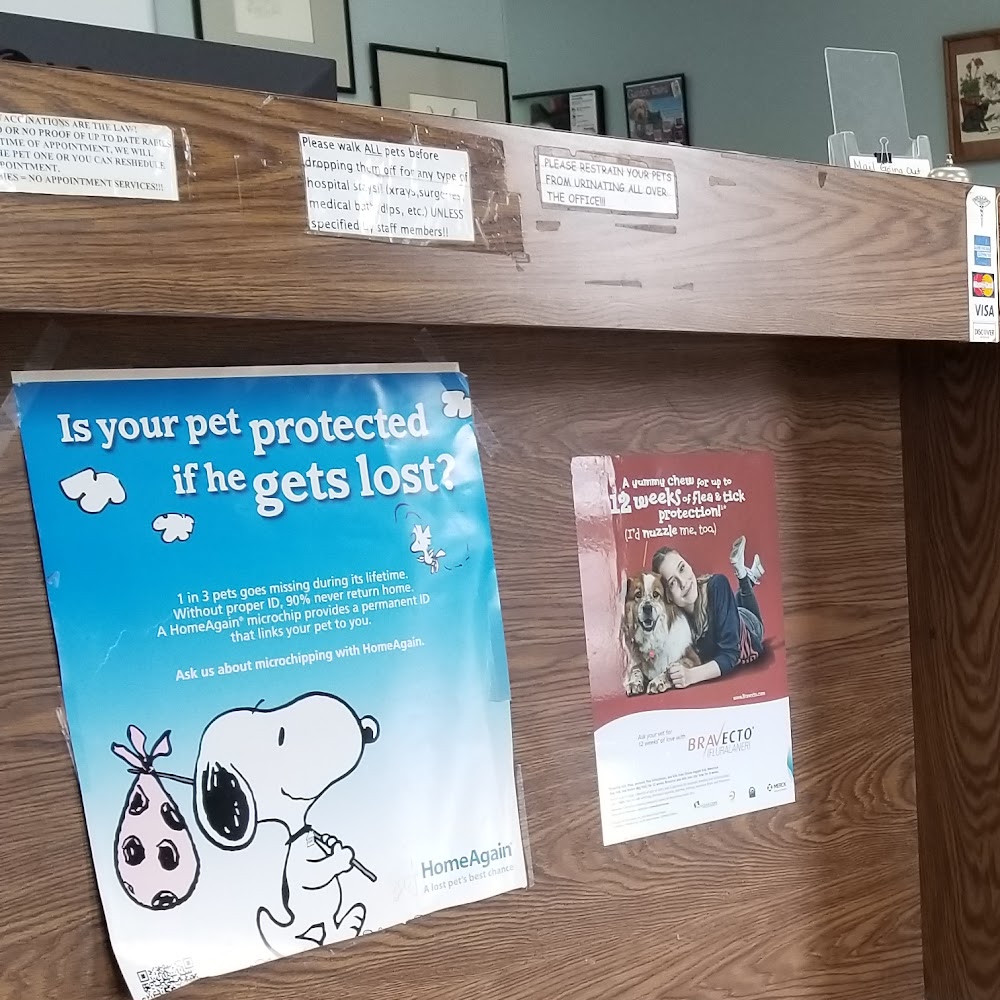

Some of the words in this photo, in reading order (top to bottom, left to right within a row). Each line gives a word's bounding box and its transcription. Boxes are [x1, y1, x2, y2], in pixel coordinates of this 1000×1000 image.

[0, 114, 70, 127] ACCINATIONS
[72, 121, 91, 130] ARE
[92, 122, 111, 131] THE
[5, 126, 20, 135] OR
[22, 128, 36, 136] NO
[39, 129, 72, 139] PROOF
[73, 131, 86, 140] OF
[88, 133, 100, 141] UP
[102, 134, 115, 142] TO
[117, 135, 140, 144] DATE
[0, 138, 25, 147] TIME
[28, 139, 41, 148] OF
[115, 148, 129, 156] WE
[130, 149, 154, 157] WILL
[13, 151, 30, 159] PET
[33, 152, 54, 161] ONE
[56, 153, 70, 162] OR
[72, 154, 91, 163] YOU
[94, 156, 113, 165] CAN
[302, 137, 335, 150] Please
[337, 142, 362, 153] walk
[364, 144, 382, 156] ALL
[385, 147, 405, 159] pets
[409, 148, 439, 161] before
[305, 157, 353, 173] dropping
[400, 166, 414, 177] for
[417, 170, 434, 182] any
[436, 171, 459, 183] type
[460, 171, 469, 182] of
[544, 158, 577, 172] PLEASE
[580, 162, 624, 177] RESTRAIN
[628, 169, 650, 179] YOUR
[652, 171, 672, 182] PETS
[853, 160, 875, 171] Mail
[906, 166, 921, 175] Out
[29, 174, 43, 183] NO
[45, 175, 112, 187] APPOINTMENT
[114, 181, 164, 191] SERVICES!!!
[307, 177, 350, 192] hospital
[546, 175, 572, 187] FROM
[574, 179, 625, 193] URINATING
[628, 184, 643, 195] ALL
[646, 187, 667, 197] OVER
[309, 198, 351, 211] medical
[380, 205, 404, 217] dips,
[407, 207, 428, 218] etc.)
[430, 208, 464, 220] UNLESS
[548, 191, 565, 203] THE
[568, 193, 606, 207] OFFICE!!!
[311, 218, 360, 231] specified
[377, 222, 398, 234] staff
[400, 225, 449, 238] members!!
[975, 304, 995, 317] VISA
[57, 413, 92, 443] Is
[95, 413, 179, 450] your
[185, 408, 242, 446] pet
[249, 402, 429, 456] protected
[171, 462, 199, 495] if
[204, 460, 247, 493] he
[252, 464, 350, 518] gets
[355, 453, 455, 497] lost?
[622, 477, 630, 489] A
[632, 477, 665, 489] yummy
[667, 474, 695, 487] chew
[696, 477, 710, 488] for
[711, 478, 722, 489] up
[723, 477, 732, 486] to
[609, 490, 632, 515] 12
[633, 487, 682, 510] weeks
[682, 496, 691, 505] of
[692, 490, 714, 505] flea
[715, 492, 722, 502] &
[723, 489, 746, 503] tick
[624, 528, 641, 542] (I'd
[642, 525, 678, 539] nuzzle
[680, 525, 697, 536] me,
[177, 593, 184, 605] 1
[186, 591, 199, 603] in
[202, 590, 209, 602] 3
[213, 588, 237, 604] pets
[240, 586, 267, 600] goes
[269, 580, 310, 596] missing
[312, 575, 349, 591] during
[350, 573, 364, 585] its
[365, 569, 409, 584] lifetime.
[173, 604, 223, 620] Without
[226, 600, 265, 617] proper
[267, 597, 283, 610] ID,
[285, 593, 311, 607] 90%
[314, 591, 344, 604] never
[346, 587, 380, 600] return
[382, 582, 414, 596] home.
[156, 625, 167, 638] A
[247, 609, 302, 626] microchip
[304, 601, 351, 620] provides
[352, 603, 359, 613] a
[361, 596, 419, 613] permanent
[419, 593, 430, 604] ID
[230, 629, 255, 643] that
[257, 624, 284, 640] links
[285, 623, 312, 640] your
[313, 621, 333, 636] pet
[335, 618, 347, 629] to
[348, 616, 372, 631] you.
[175, 668, 199, 682] Ask
[201, 666, 215, 677] us
[217, 659, 253, 675] about
[255, 645, 334, 671] microchipping
[335, 644, 361, 658] with
[362, 637, 425, 656] HomeAgain.
[423, 885, 430, 894] A
[431, 880, 447, 892] lost
[447, 875, 468, 890] pet's
[468, 870, 487, 882] best
[487, 865, 515, 877] chance
